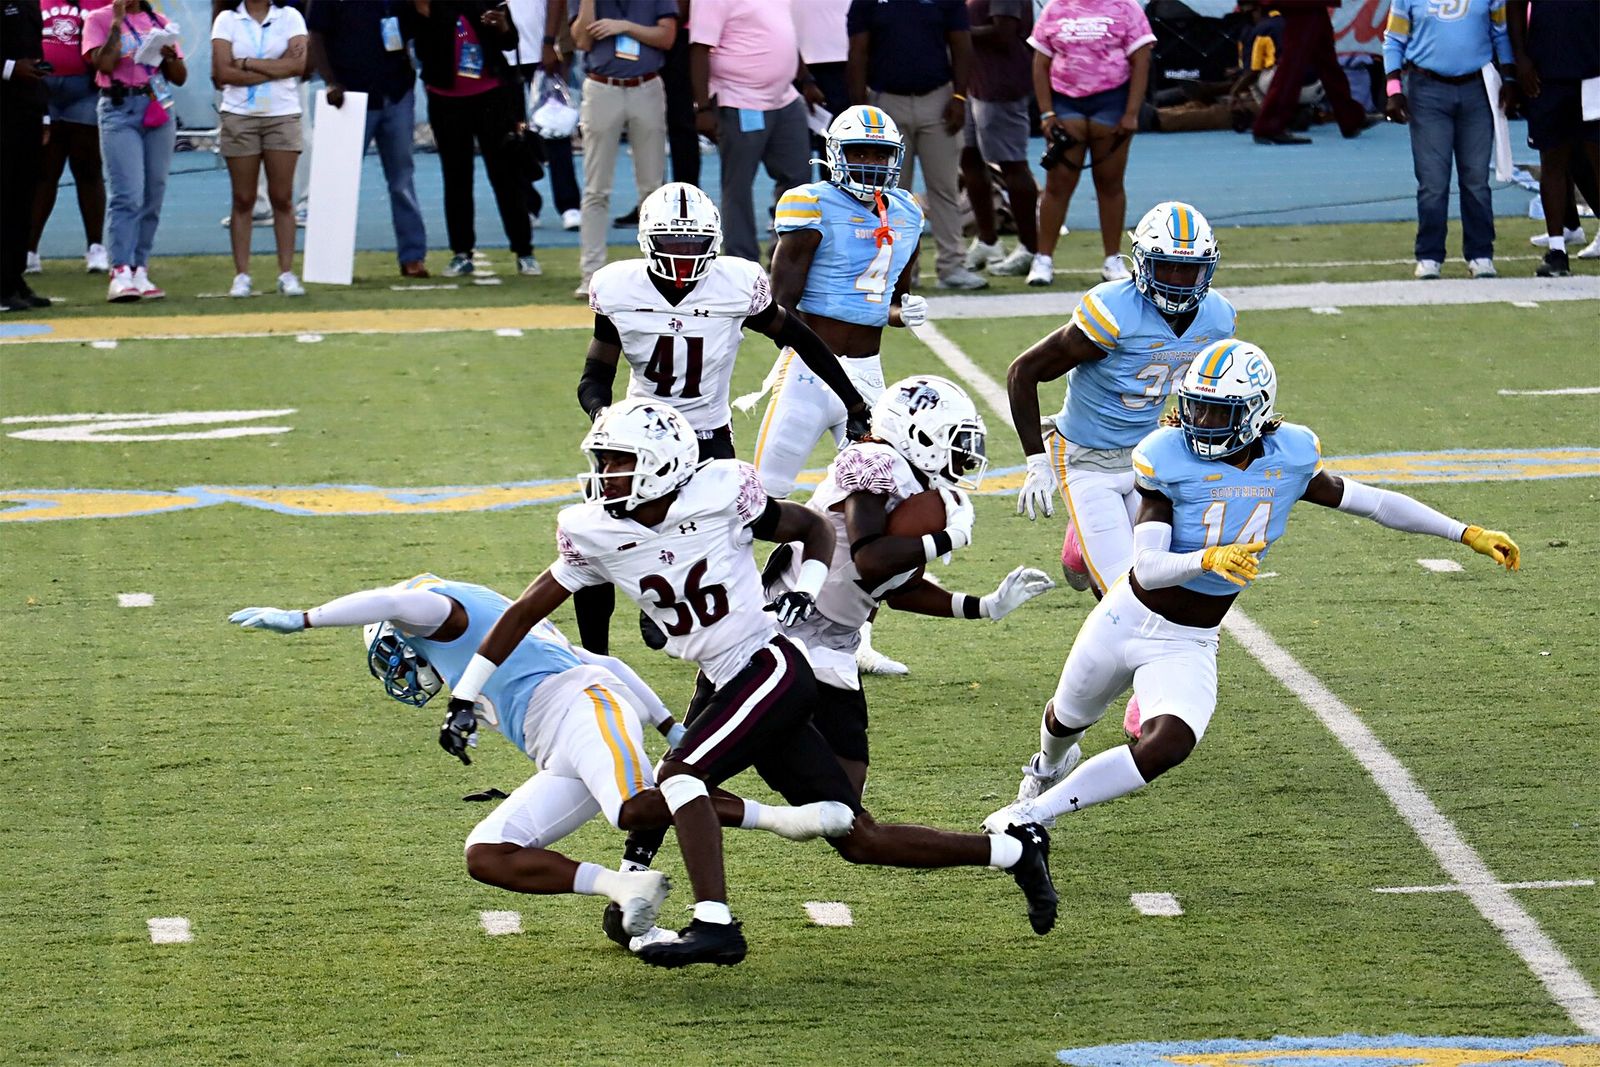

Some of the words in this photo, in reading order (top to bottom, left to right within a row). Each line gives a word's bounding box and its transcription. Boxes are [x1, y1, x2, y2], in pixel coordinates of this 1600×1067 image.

[855, 243, 893, 303] 4
[643, 334, 704, 398] 41
[1210, 486, 1275, 498] SOUTHERN
[1202, 500, 1273, 556] 14
[639, 558, 730, 637] 36
